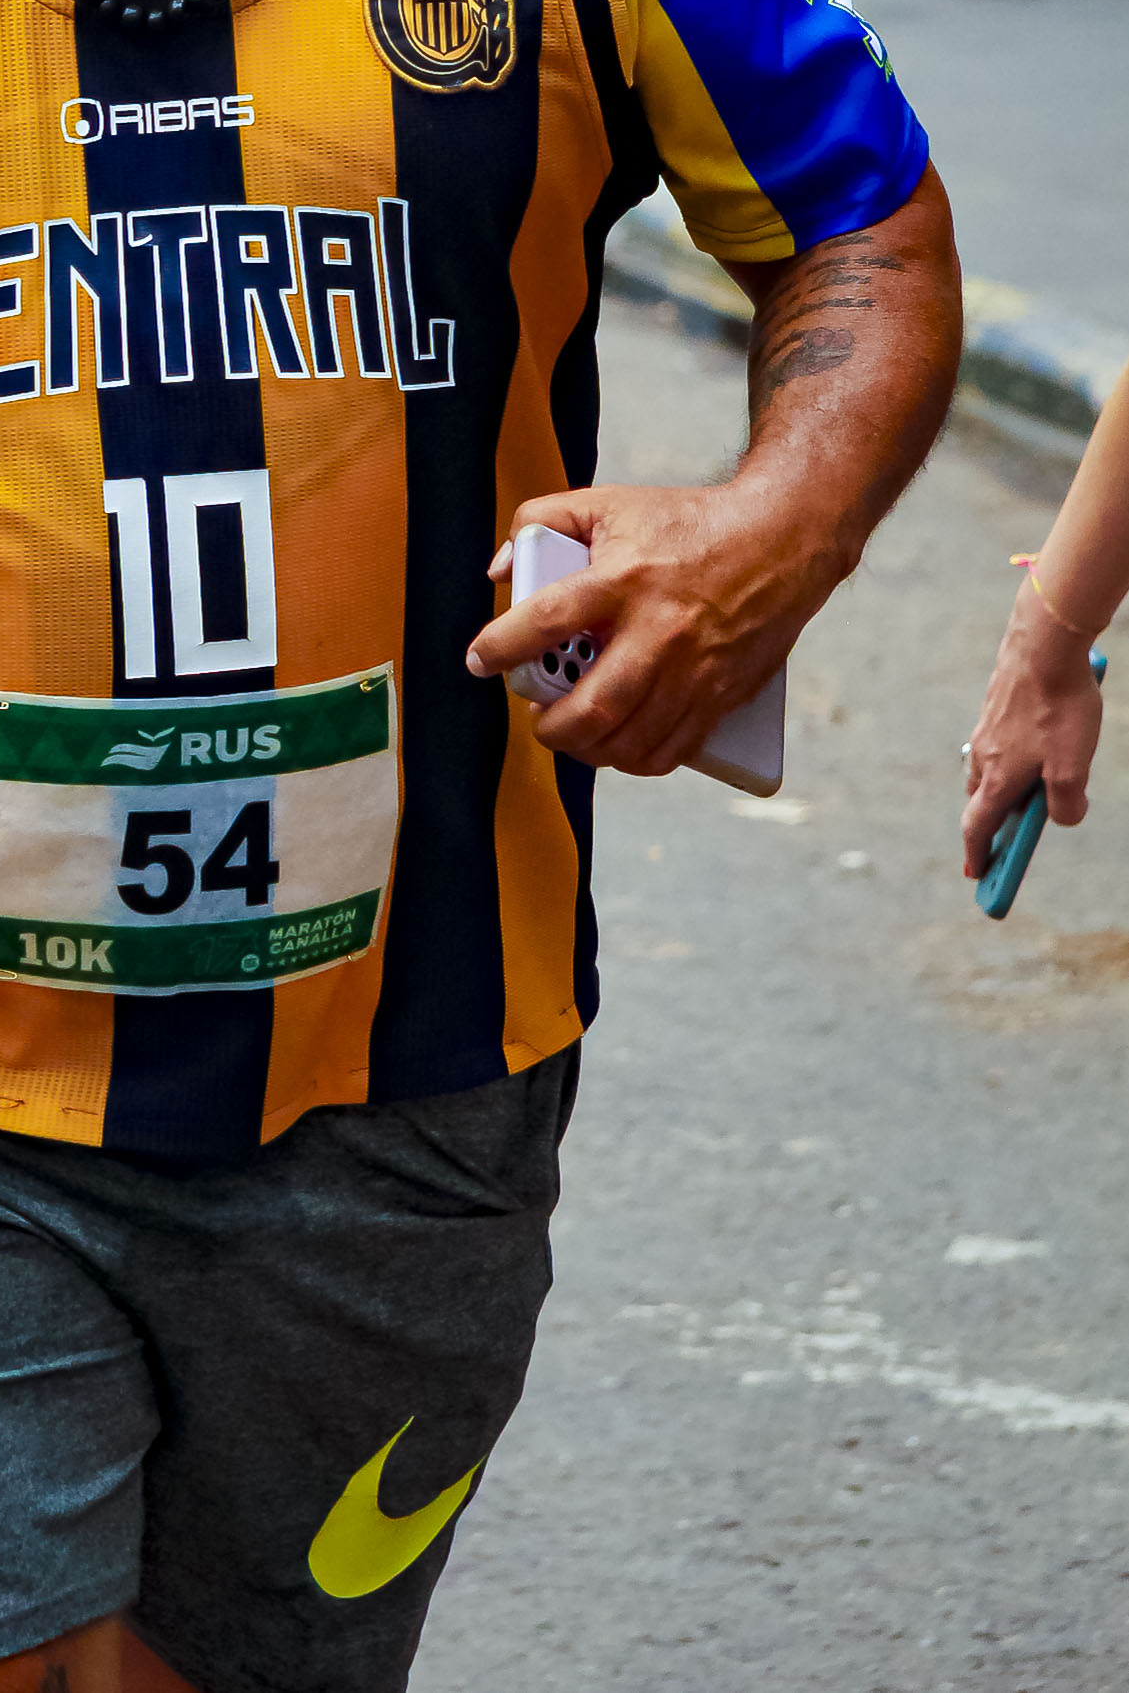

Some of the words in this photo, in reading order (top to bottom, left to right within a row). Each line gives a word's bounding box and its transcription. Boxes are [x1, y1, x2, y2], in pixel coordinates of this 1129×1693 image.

[109, 94, 256, 136] RIBAS
[103, 469, 277, 679] 10
[180, 724, 282, 767] RUS
[117, 800, 280, 916] 54
[269, 908, 357, 941] MARATÓN
[269, 923, 353, 955] CANALLA
[17, 932, 115, 974] 10K
